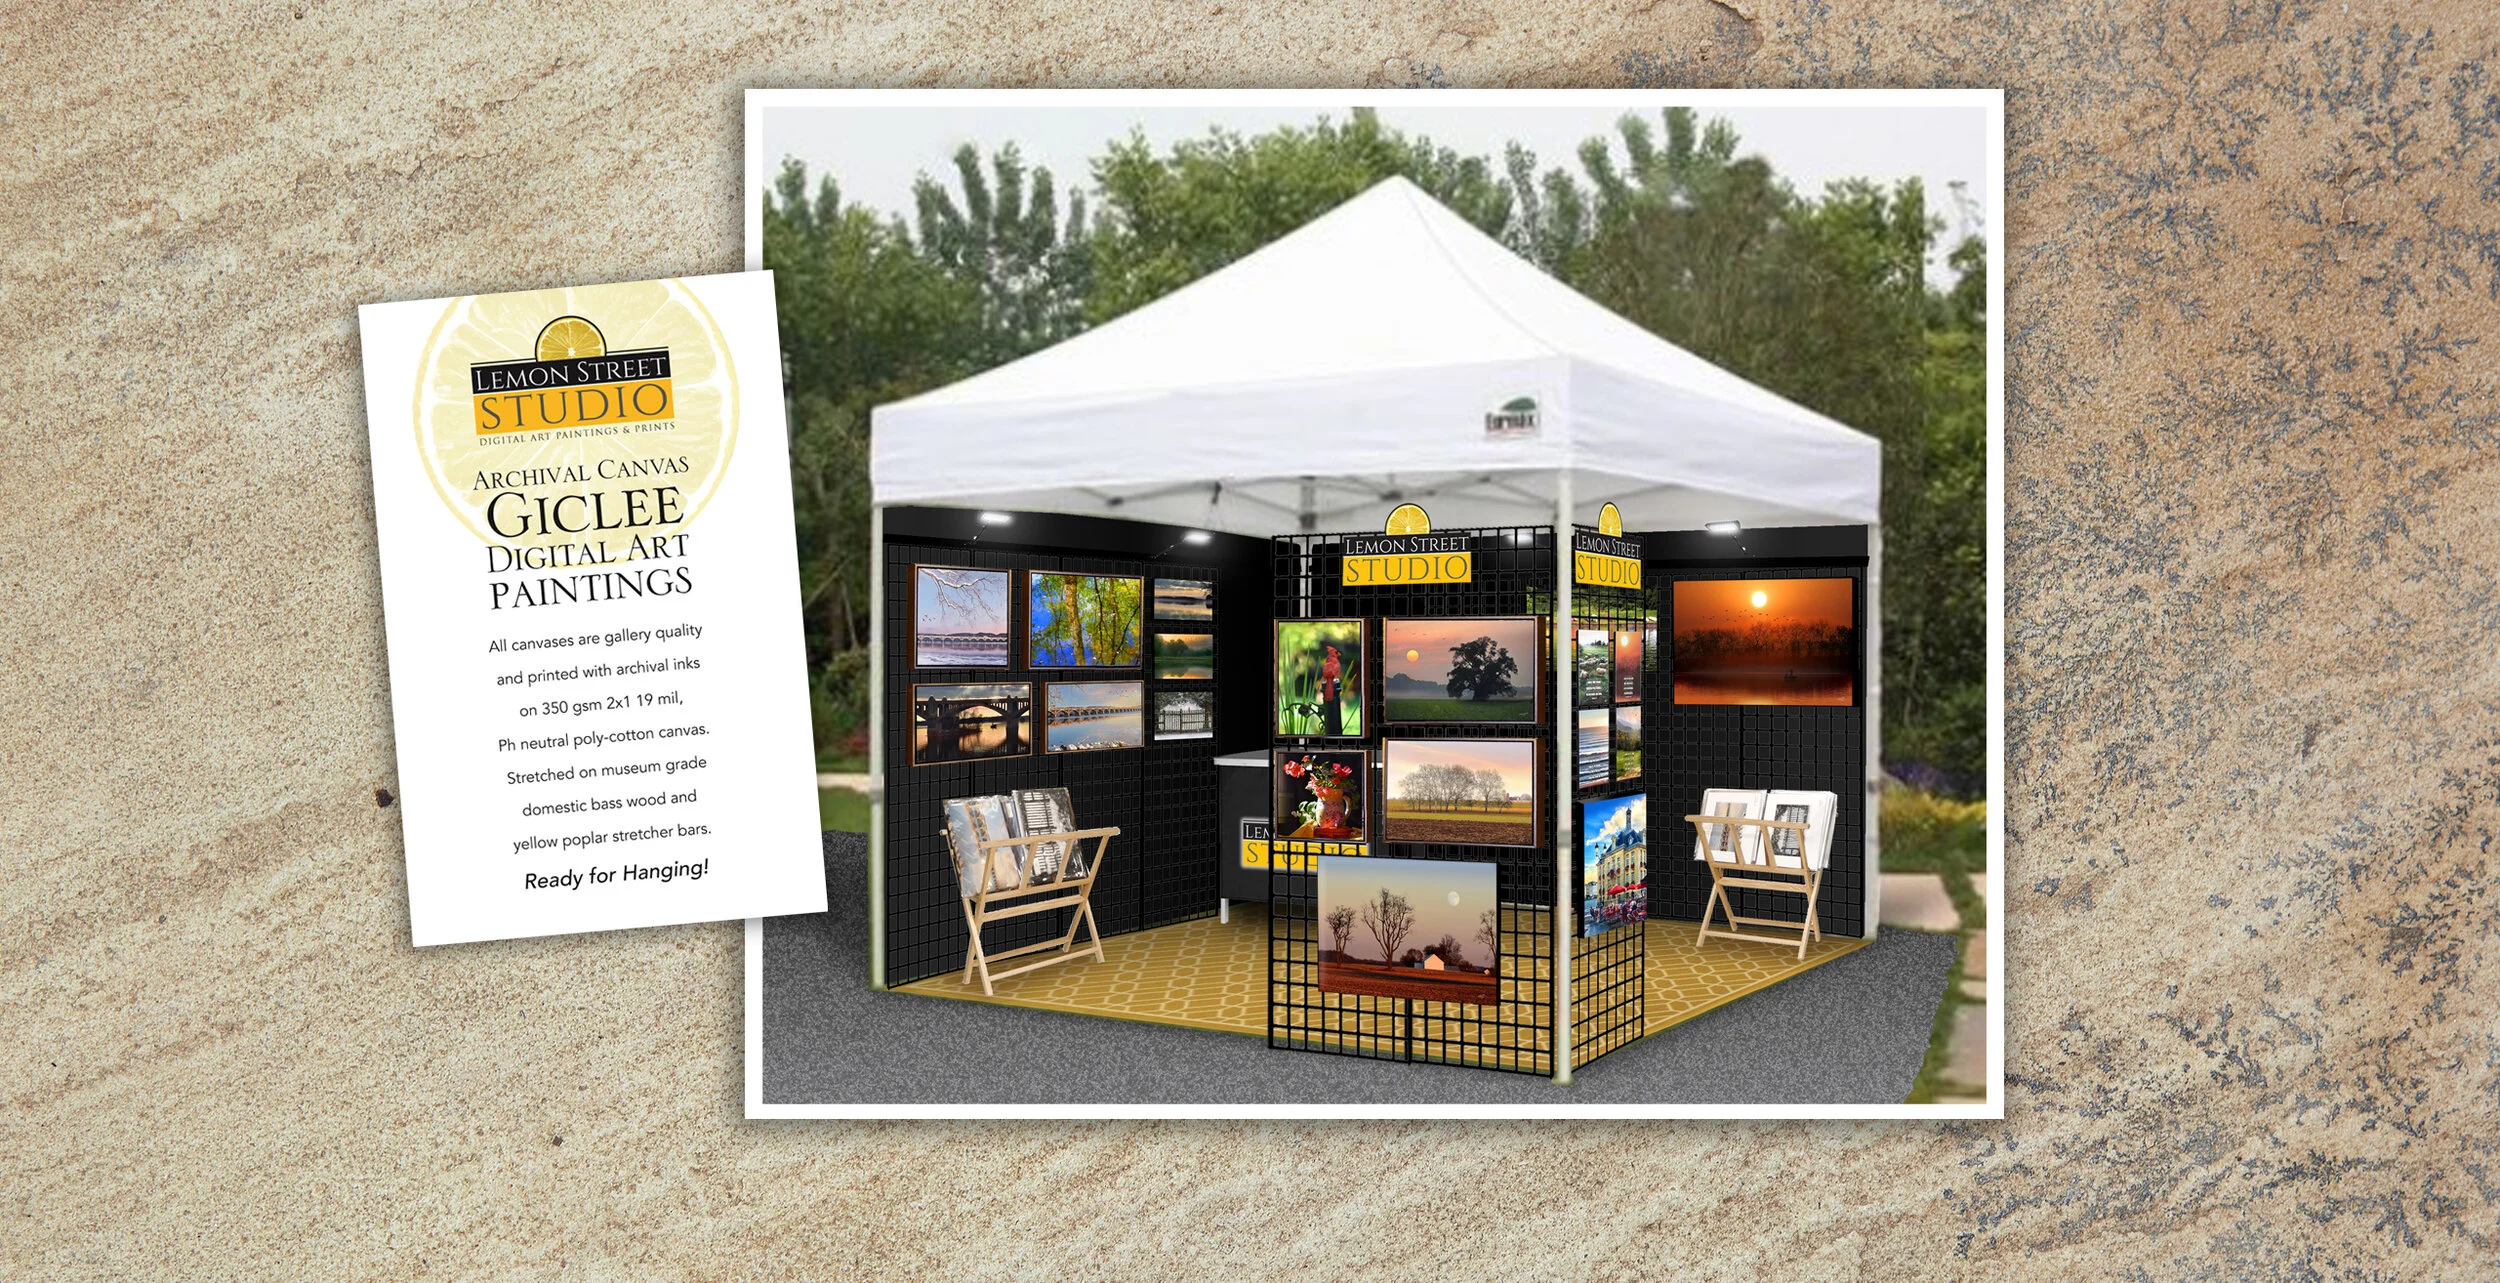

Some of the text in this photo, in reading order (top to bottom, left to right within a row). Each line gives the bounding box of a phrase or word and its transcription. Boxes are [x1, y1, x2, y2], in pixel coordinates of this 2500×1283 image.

[475, 356, 667, 391] LEMON STREET
[481, 383, 668, 430] STUDIO
[479, 422, 676, 446] DIGITAL ART PAINTINGS & PRINTS
[473, 456, 689, 491] ARCHIVAL CANVAS
[486, 486, 684, 538] GICLEE
[486, 533, 689, 574] DIGITAL ART
[1346, 536, 1469, 554] LEMON STREET
[1576, 532, 1641, 558] LEMON STREET
[1346, 555, 1467, 582] STUDIO
[1578, 554, 1639, 586] STUDIO
[489, 566, 693, 610] PAINTINGS
[488, 623, 703, 653] All canvases are gallery quality
[497, 656, 701, 687] and printed with archival inks
[519, 690, 683, 717] on 350 gsm 2x1 19 mil,
[498, 725, 710, 752] Ph neutral poly-cotton canvas.
[507, 755, 707, 785] Stretched on museum grade
[522, 788, 697, 817] domestic bass wood and
[513, 823, 712, 855] yellow poplar stretcher bars.
[525, 857, 709, 891] Ready for Hanging!
